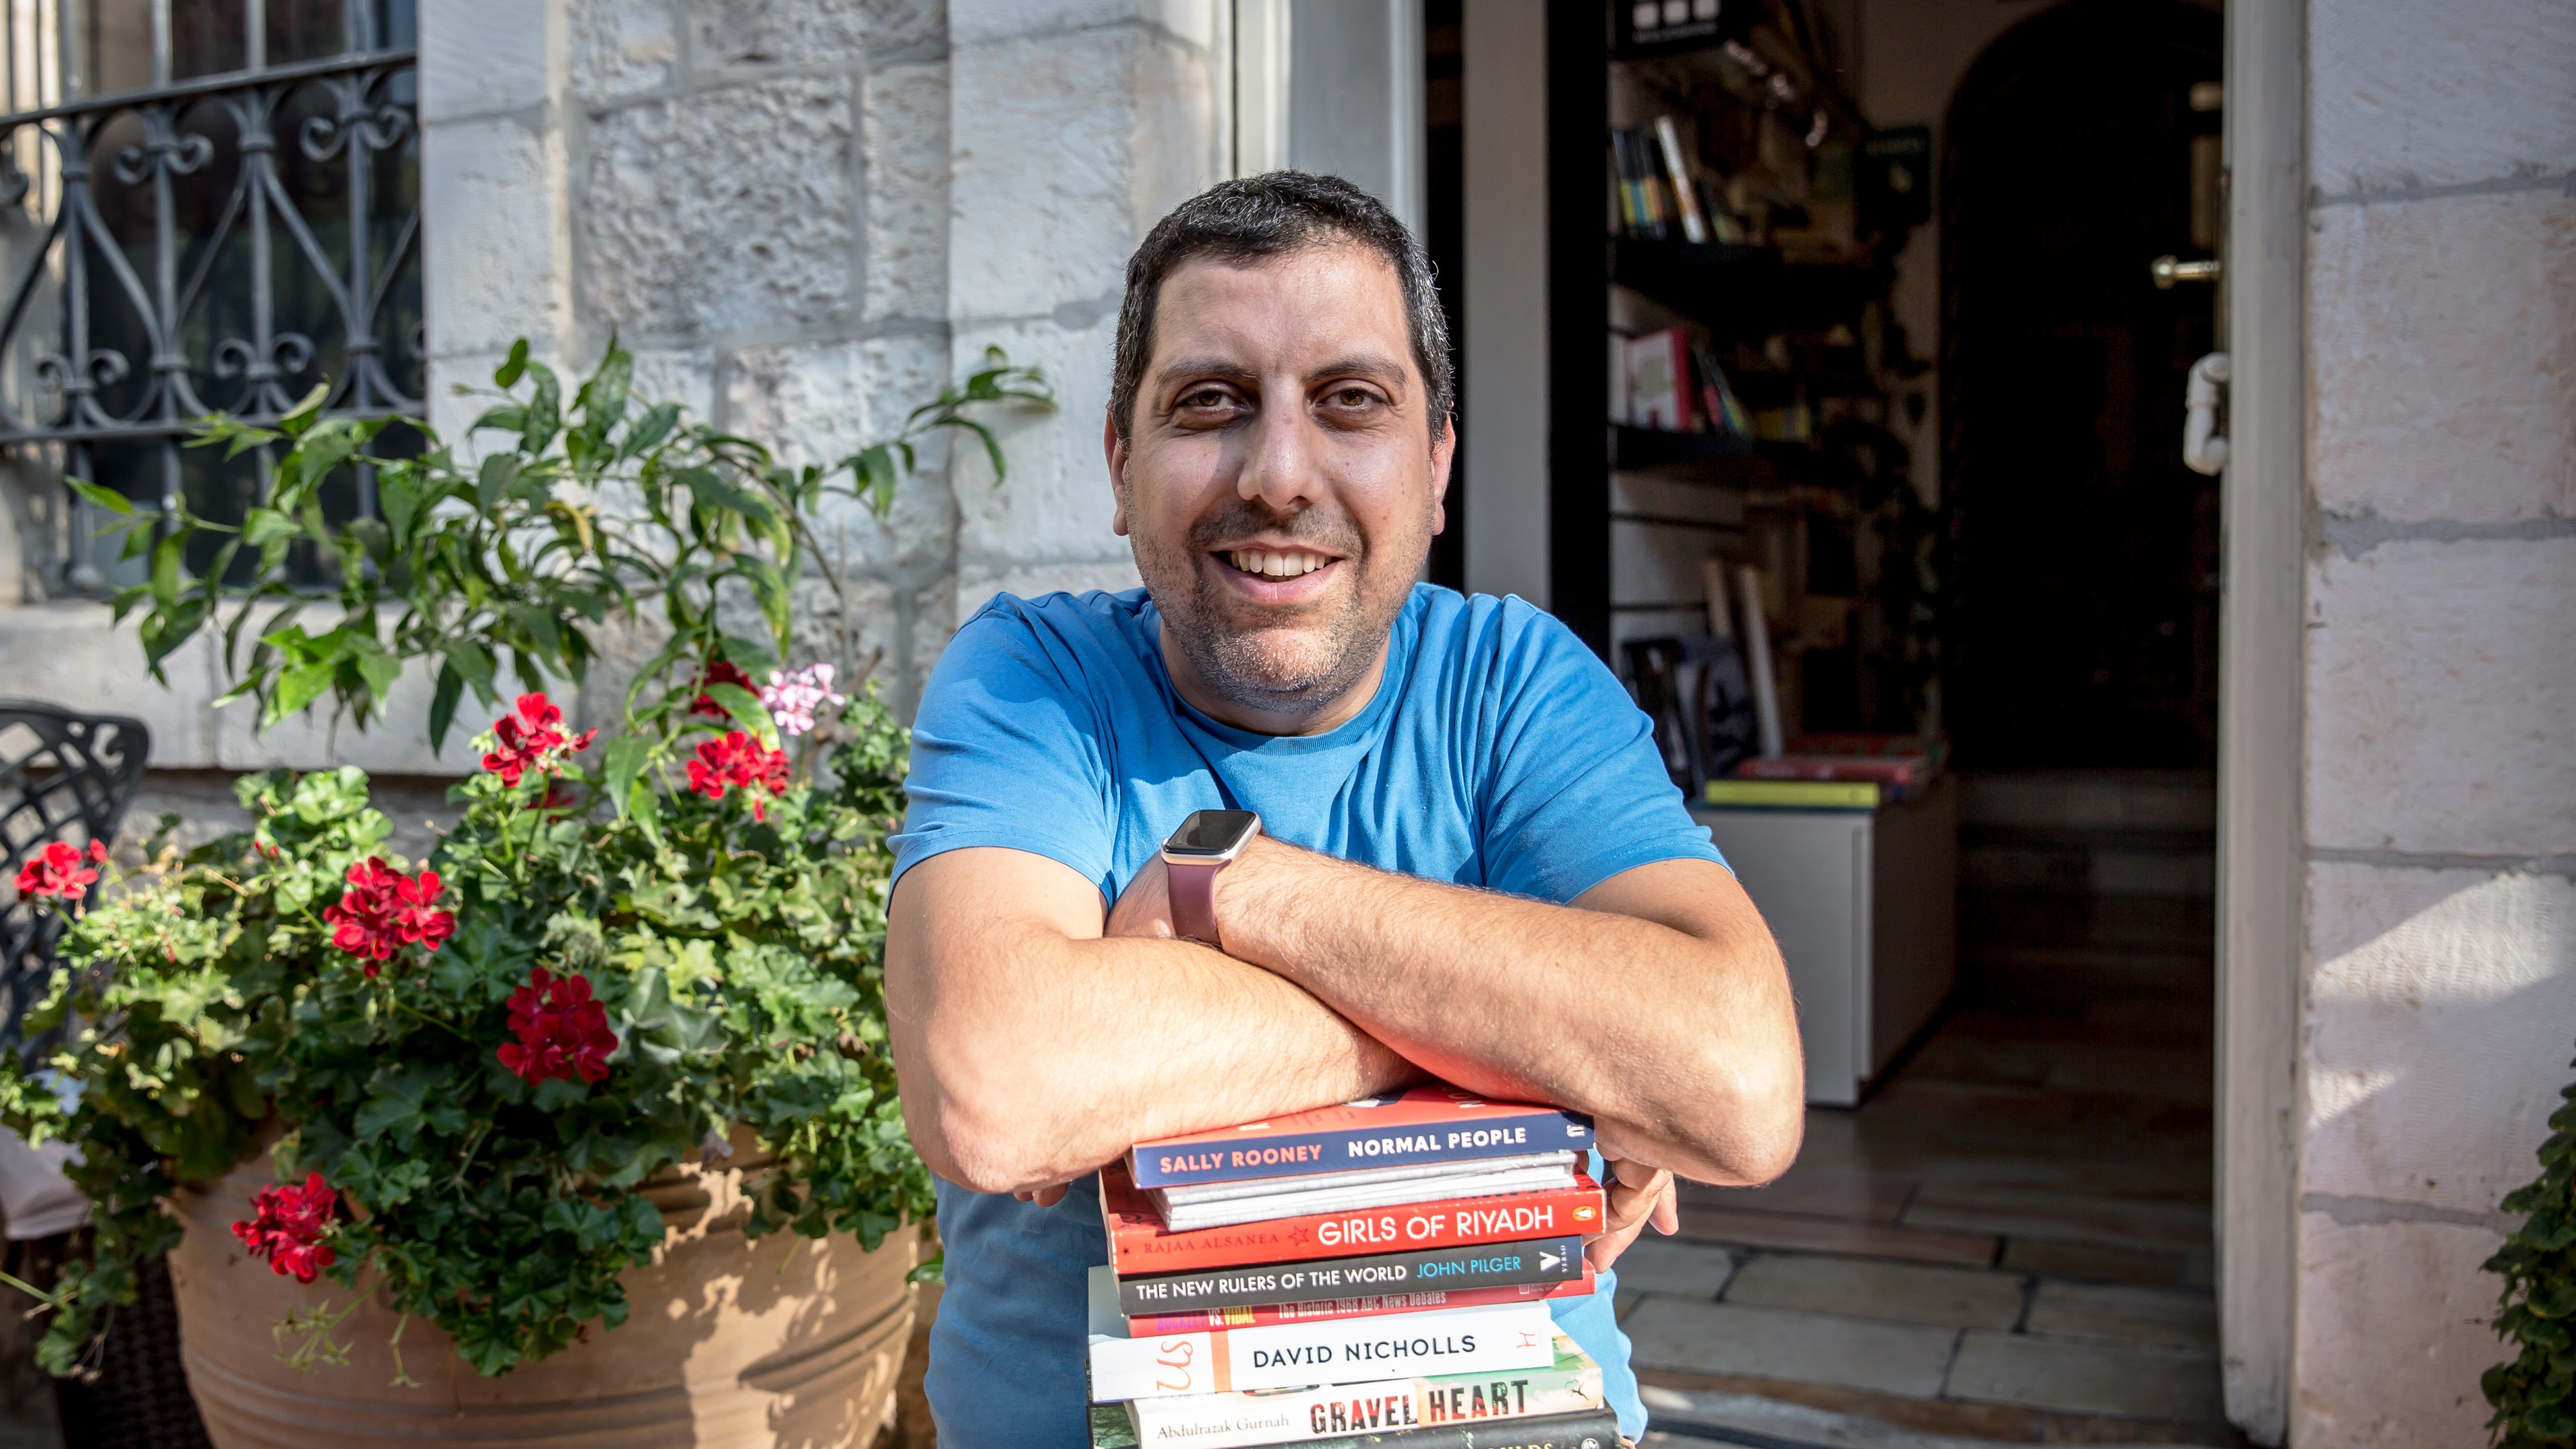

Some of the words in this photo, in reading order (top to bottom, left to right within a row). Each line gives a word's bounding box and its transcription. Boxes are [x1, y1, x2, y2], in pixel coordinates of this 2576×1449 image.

[1348, 1134, 1441, 1157] NORMAL
[1448, 1127, 1526, 1149] PEOPLE
[1160, 1152, 1224, 1173] SALLY
[1231, 1144, 1322, 1168] ROONEY
[1318, 1217, 1397, 1245] GIRLS
[1406, 1215, 1445, 1240] OF
[1457, 1205, 1553, 1236] RIYADH
[1144, 1240, 1195, 1253] RAJAA
[1202, 1233, 1279, 1249] ALSANEA
[1136, 1283, 1168, 1300] THE
[1173, 1280, 1214, 1297] NEW
[1219, 1275, 1276, 1294] RULERS
[1281, 1273, 1305, 1289] OF
[1309, 1270, 1341, 1287] THE
[1344, 1265, 1406, 1284] WORLD
[1417, 1261, 1465, 1278] JOHN
[1471, 1256, 1522, 1274] PILGER
[1157, 1309, 1206, 1331] BUCKLEY
[1208, 1309, 1223, 1327] VS.
[1224, 1306, 1255, 1326] VIDAL
[1278, 1303, 1295, 1319] The
[1297, 1300, 1334, 1317] Historic
[1336, 1298, 1358, 1313] 1968
[1361, 1296, 1380, 1311] ABC
[1383, 1294, 1406, 1309] News
[1410, 1291, 1446, 1306] Debates
[1253, 1345, 1332, 1368] DAVID
[1345, 1335, 1476, 1361] NICHOLLS
[1311, 1394, 1418, 1434] GRAVEL
[1429, 1379, 1529, 1422] HEART
[1157, 1419, 1232, 1439] Abdulrazak
[1236, 1414, 1289, 1431] Gurnah
